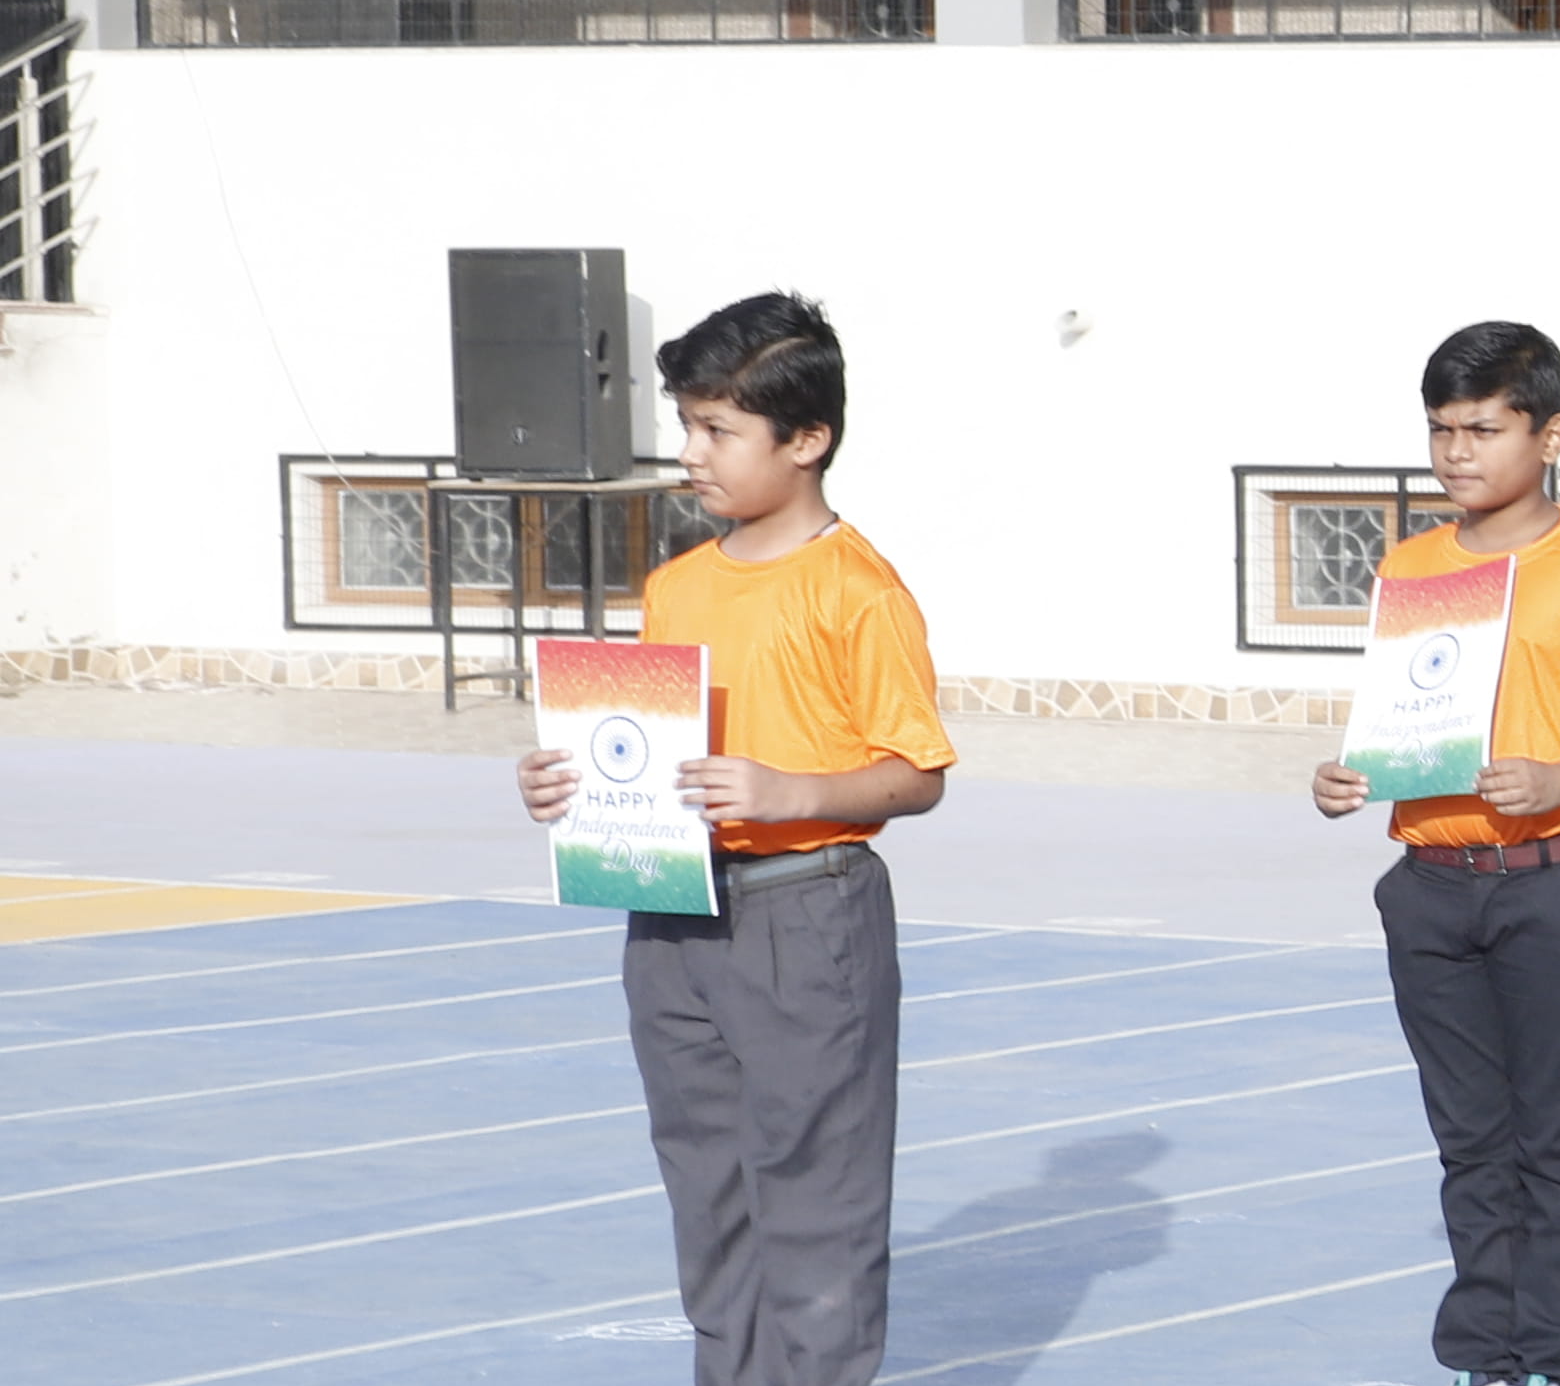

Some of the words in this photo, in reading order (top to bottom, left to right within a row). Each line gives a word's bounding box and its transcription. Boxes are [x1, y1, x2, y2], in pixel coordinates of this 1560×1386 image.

[1393, 693, 1455, 714] HAPPY
[587, 789, 657, 811] HAPPY
[560, 804, 690, 844] Independence
[600, 837, 665, 886] Day
